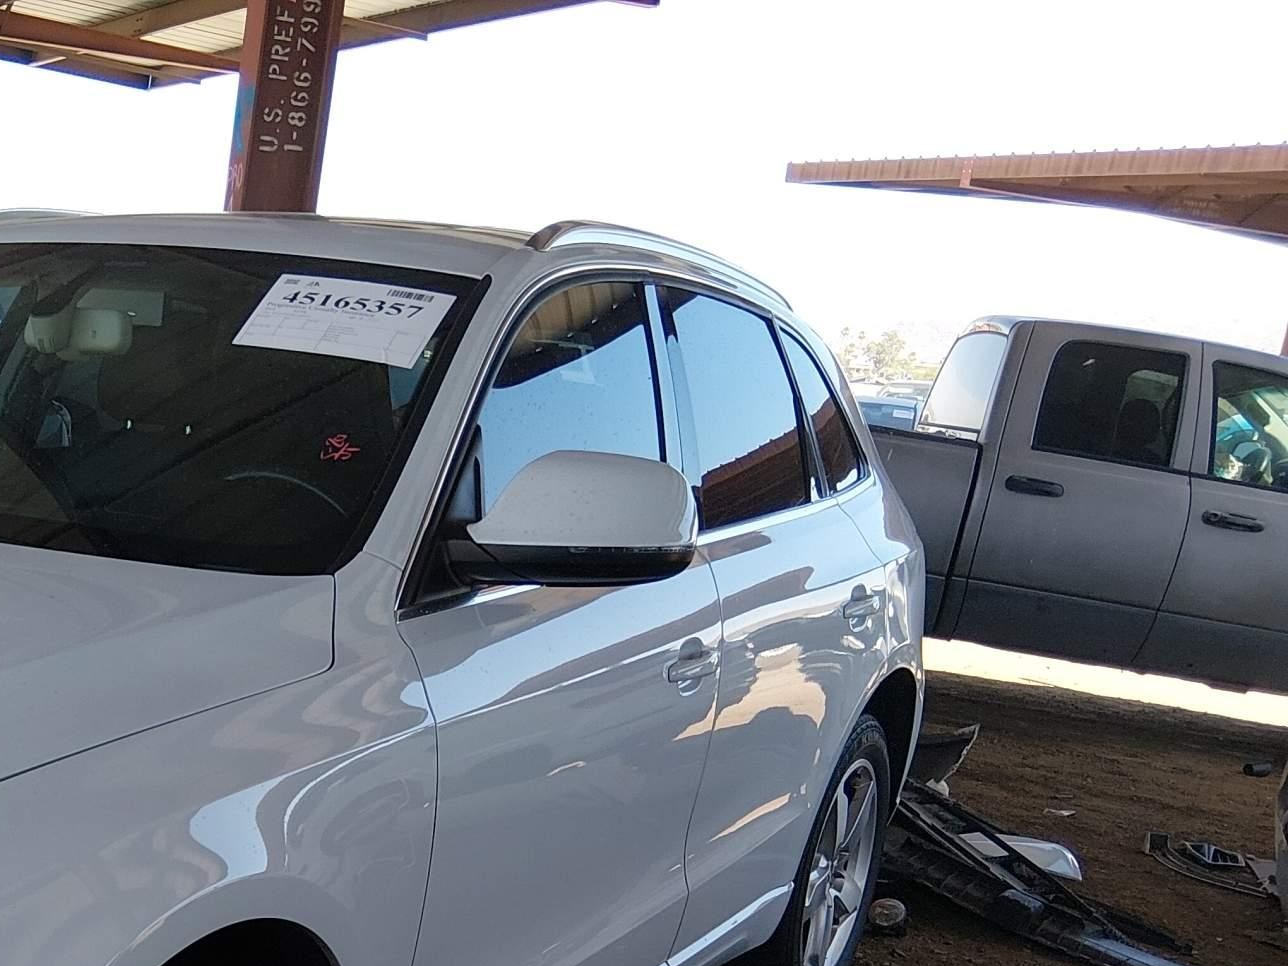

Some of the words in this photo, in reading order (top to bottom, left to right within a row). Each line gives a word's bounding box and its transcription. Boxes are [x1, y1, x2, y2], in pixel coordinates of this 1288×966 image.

[268, 0, 298, 81] PREF
[259, 99, 286, 152] U.S.
[282, 290, 425, 319] 45165357
